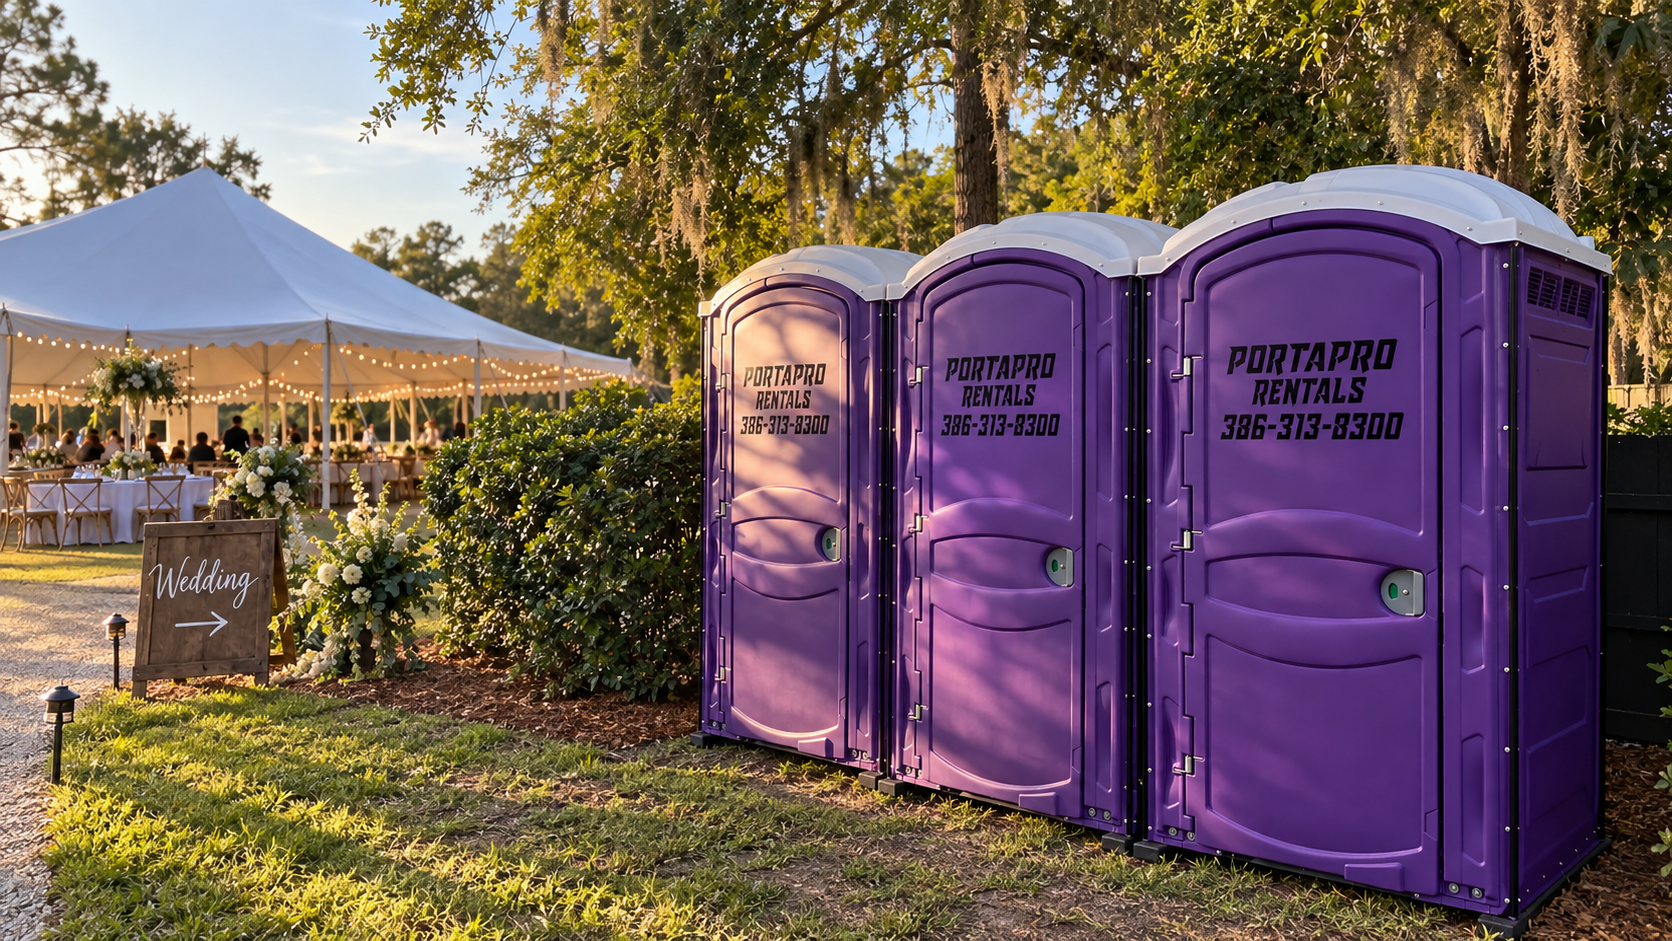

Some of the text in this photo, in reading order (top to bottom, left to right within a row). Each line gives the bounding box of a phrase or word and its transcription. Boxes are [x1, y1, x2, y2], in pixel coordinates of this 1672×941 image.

[945, 352, 1056, 383] PORTAPRO
[1226, 338, 1398, 376] PORTAPRO
[743, 363, 827, 388] PORTAPRO
[755, 390, 812, 410] RENTALS
[961, 384, 1036, 408] RENTALS
[1252, 376, 1367, 407] RENTALS
[740, 415, 830, 435] 386-313-8300
[940, 413, 1061, 436] 386-313-8300
[1220, 412, 1404, 440] 386-313-8300
[148, 556, 259, 609] Wedding
